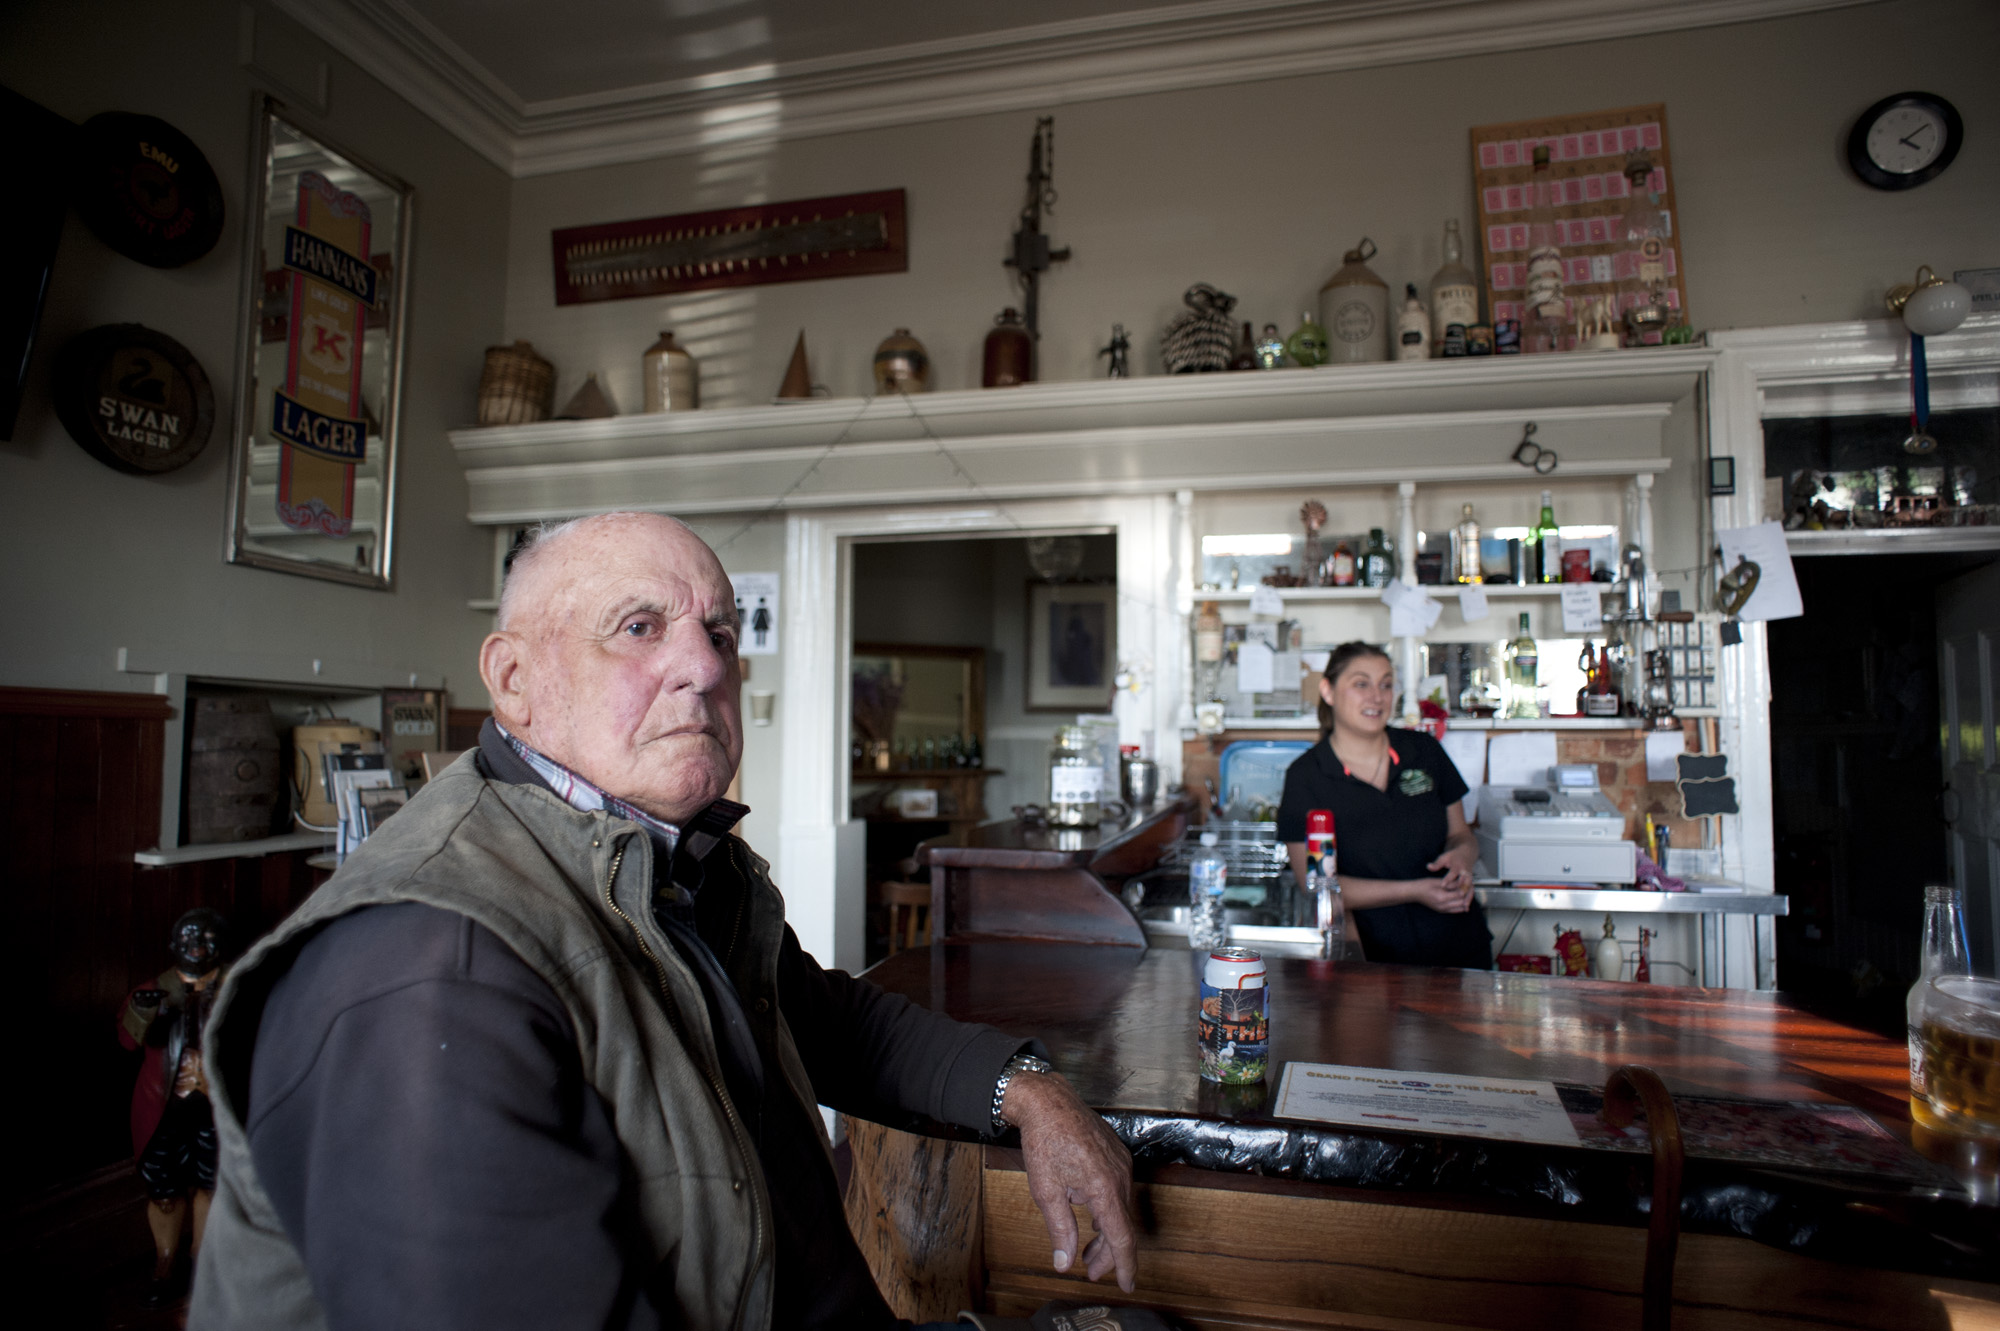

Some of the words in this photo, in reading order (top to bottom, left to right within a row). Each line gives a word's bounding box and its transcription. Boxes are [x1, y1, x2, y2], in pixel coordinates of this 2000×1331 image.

[138, 141, 179, 174] EMU
[292, 232, 369, 297] HANNANS
[311, 324, 346, 361] K
[99, 396, 180, 436] SWAN
[281, 400, 358, 455] LAGER
[106, 420, 170, 450] LAGER
[393, 719, 436, 736] GOLD
[394, 706, 435, 721] SWAN
[1305, 1071, 1351, 1081] GRAND
[1455, 1084, 1481, 1092] THE
[1483, 1086, 1538, 1096] DECADE
